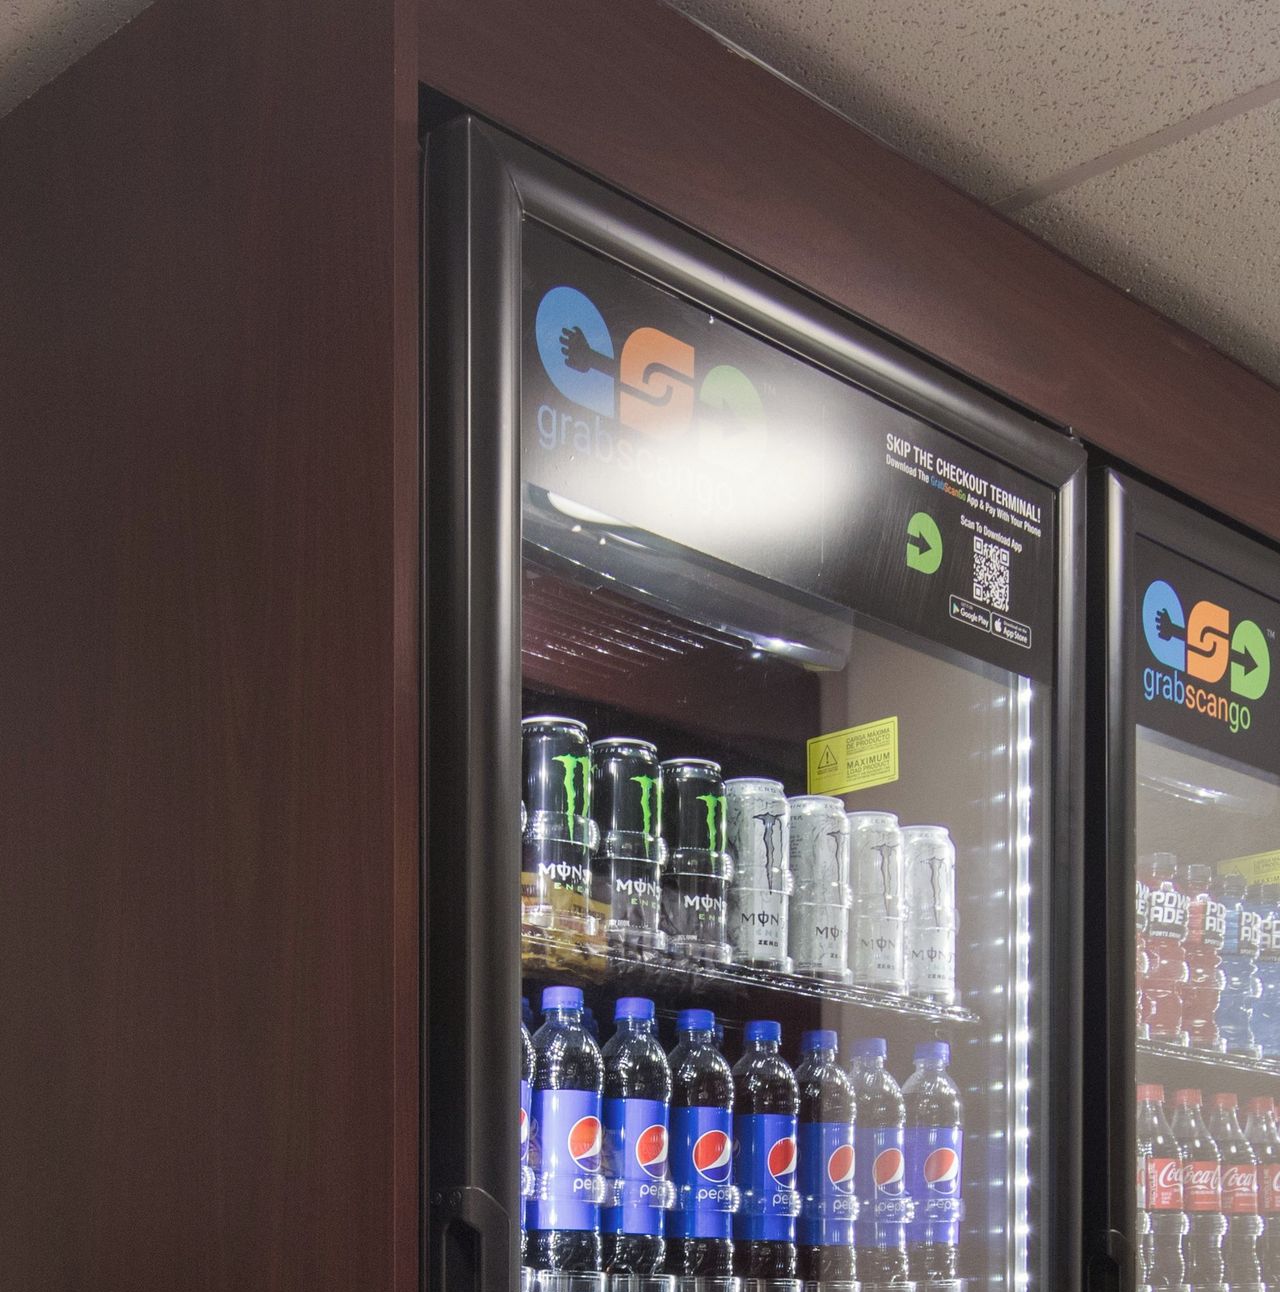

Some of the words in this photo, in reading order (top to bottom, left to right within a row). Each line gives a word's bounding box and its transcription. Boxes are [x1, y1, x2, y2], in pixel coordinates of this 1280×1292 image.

[886, 433, 911, 458] SKIP
[913, 446, 934, 471] THE
[936, 458, 989, 497] CHECKOUT
[990, 484, 1041, 523] TERMINAL!
[886, 454, 917, 477] Download
[918, 469, 930, 484] The
[967, 494, 979, 508] App
[979, 499, 985, 511] &
[985, 502, 997, 517] Pay
[997, 507, 1010, 522] With
[1010, 514, 1023, 529] Your
[1024, 520, 1042, 537] Phone
[961, 515, 975, 530] Scan
[976, 521, 983, 533] To
[983, 525, 1011, 547] Download
[1011, 539, 1023, 553] App
[960, 607, 978, 623] Google
[978, 615, 989, 628] Play
[1003, 627, 1014, 639] App
[1014, 631, 1028, 644] Store
[1143, 667, 1251, 733] grabscango
[856, 734, 890, 748] PRODUCTO
[847, 752, 890, 769] MAXIMUM
[698, 1188, 731, 1202] peps
